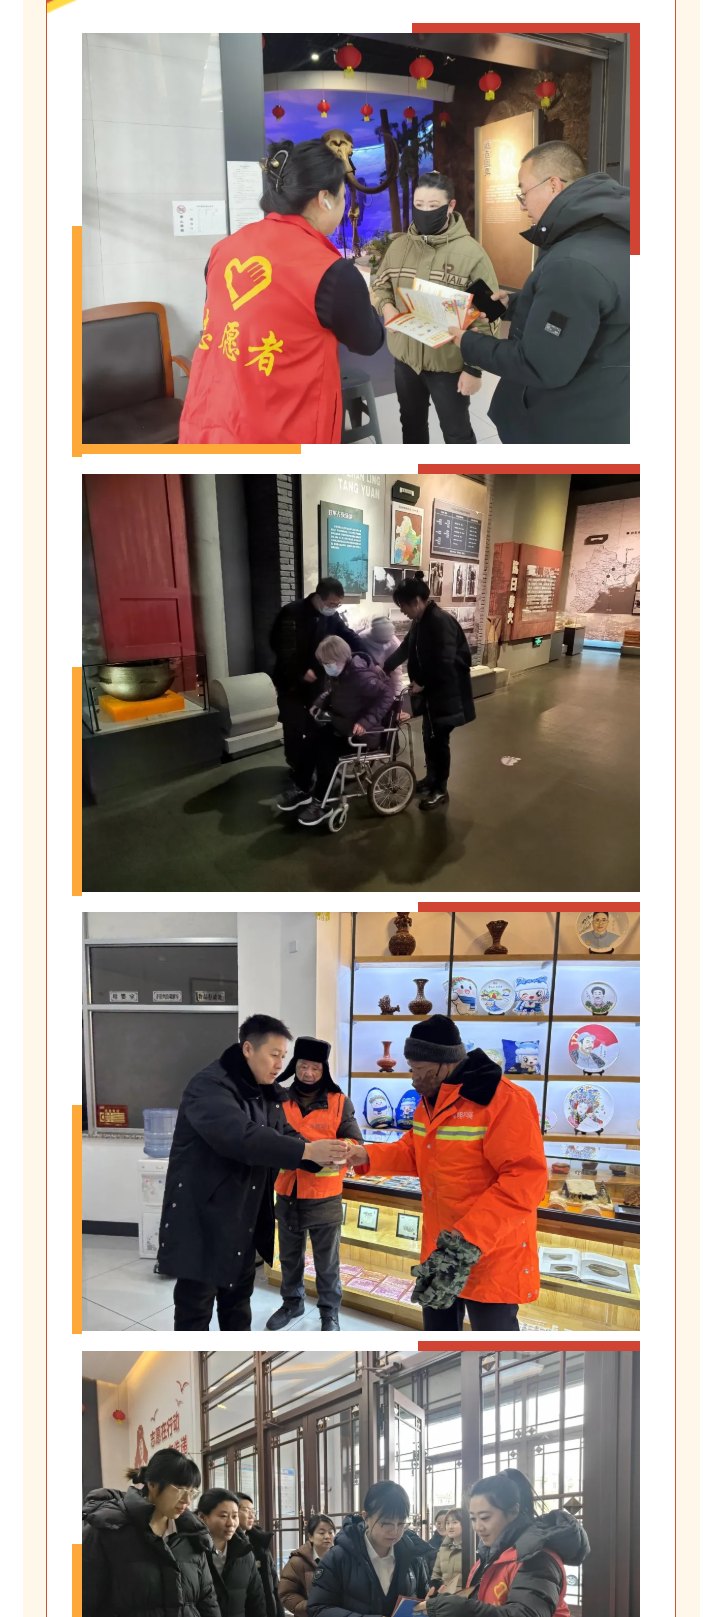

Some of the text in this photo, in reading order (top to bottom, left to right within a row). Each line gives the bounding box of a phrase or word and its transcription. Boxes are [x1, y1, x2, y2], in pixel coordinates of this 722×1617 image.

[337, 478, 359, 494] TANG
[361, 484, 380, 500] YUAN
[149, 1411, 180, 1448] 志愿在行动
